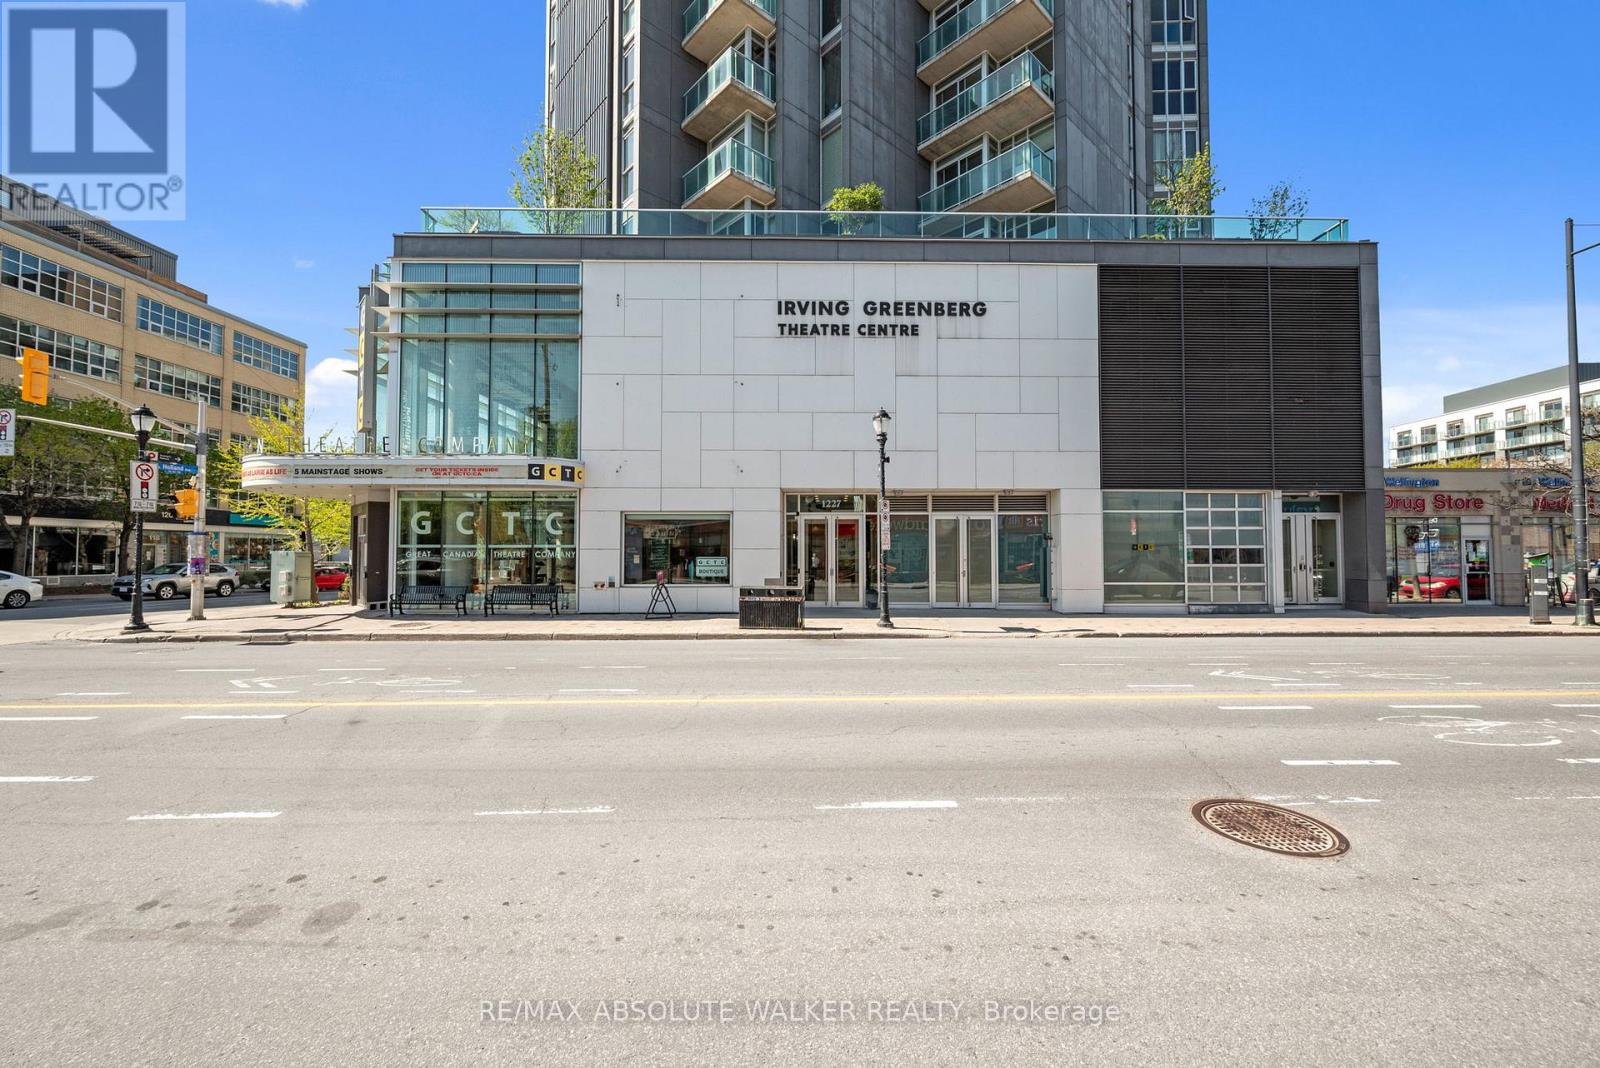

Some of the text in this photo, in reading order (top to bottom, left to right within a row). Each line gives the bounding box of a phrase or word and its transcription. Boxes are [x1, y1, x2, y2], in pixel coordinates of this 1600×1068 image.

[777, 300, 987, 317] IRVING GREENBERG
[778, 323, 919, 336] THEATRE CENTRE
[822, 499, 842, 508] 1227
[1384, 493, 1484, 512] Drug Store
[534, 551, 576, 559] COMPANY
